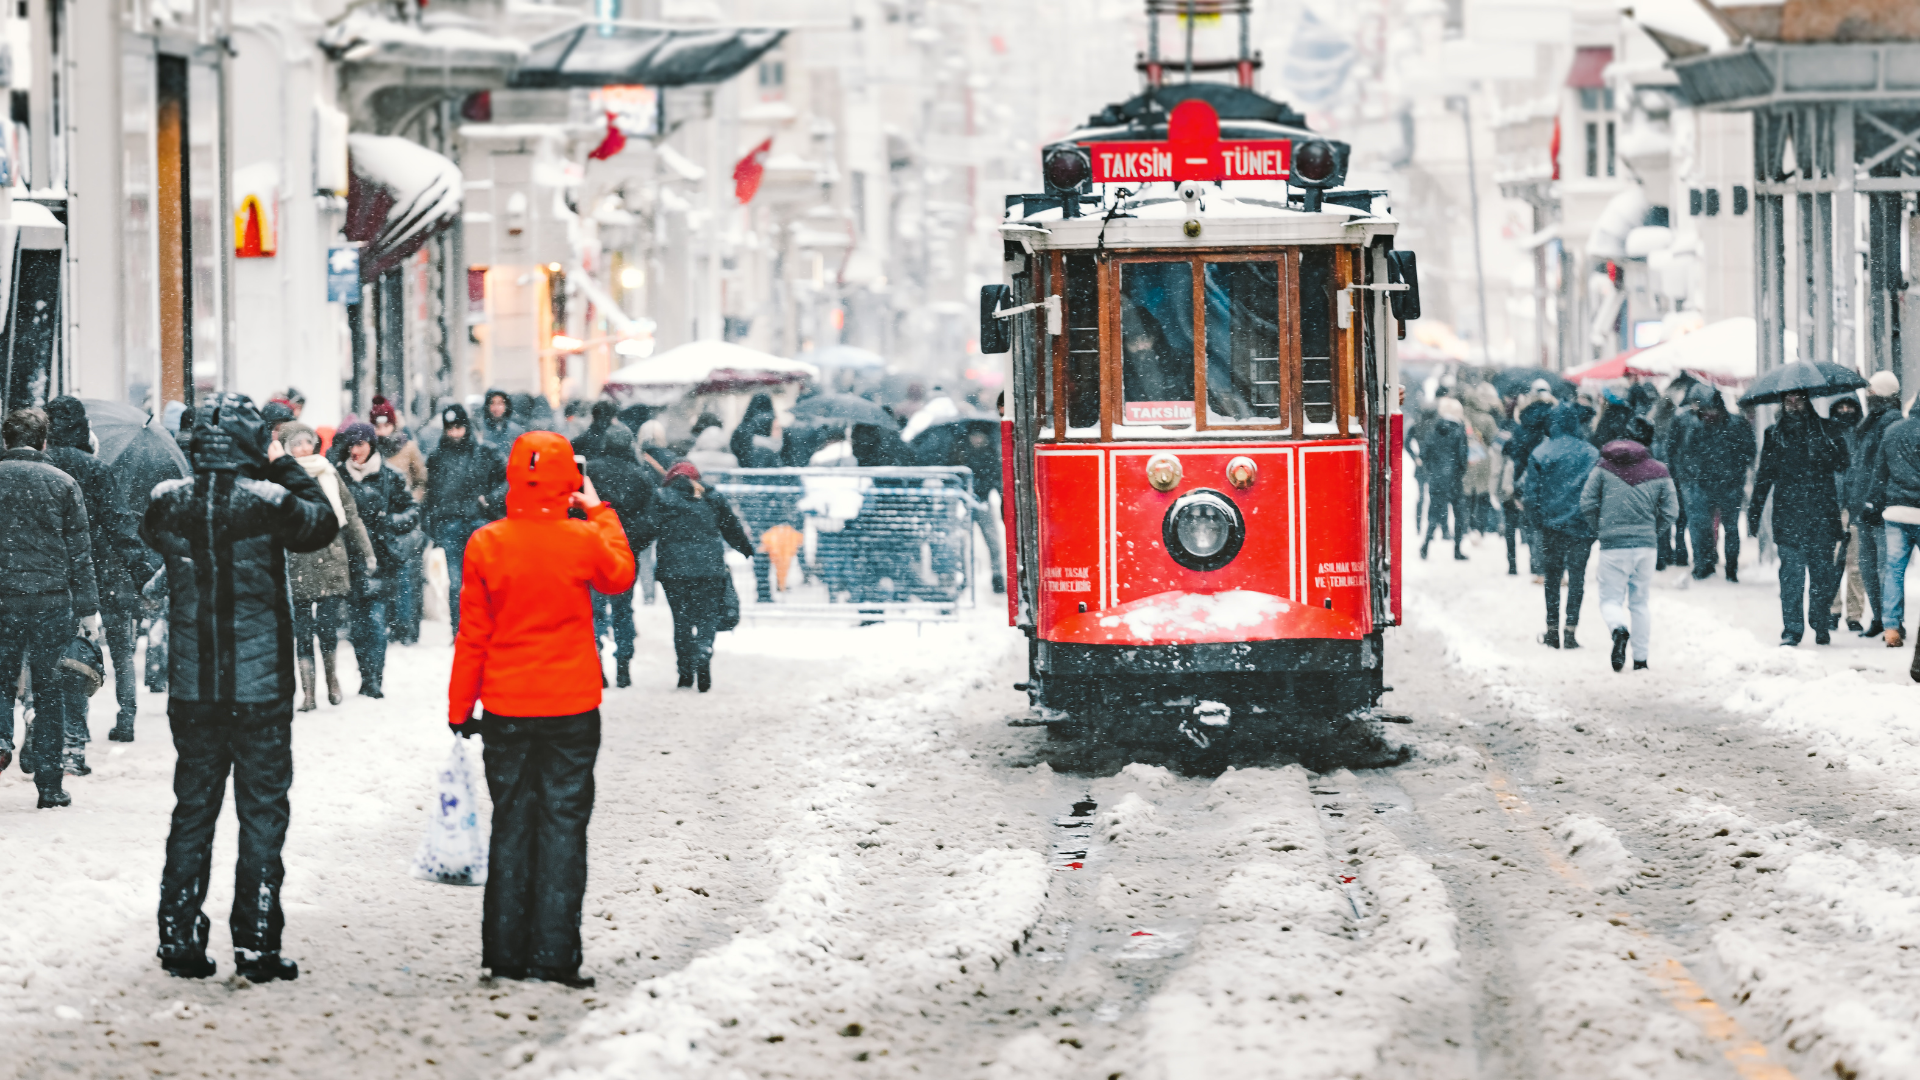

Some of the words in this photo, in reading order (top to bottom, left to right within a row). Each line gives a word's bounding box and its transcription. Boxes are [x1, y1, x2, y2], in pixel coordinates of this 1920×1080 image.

[1100, 147, 1172, 178] TAKSİM
[1221, 146, 1290, 176] TÜNEL
[1130, 404, 1192, 419] TAKSİM
[1314, 576, 1327, 588] VE
